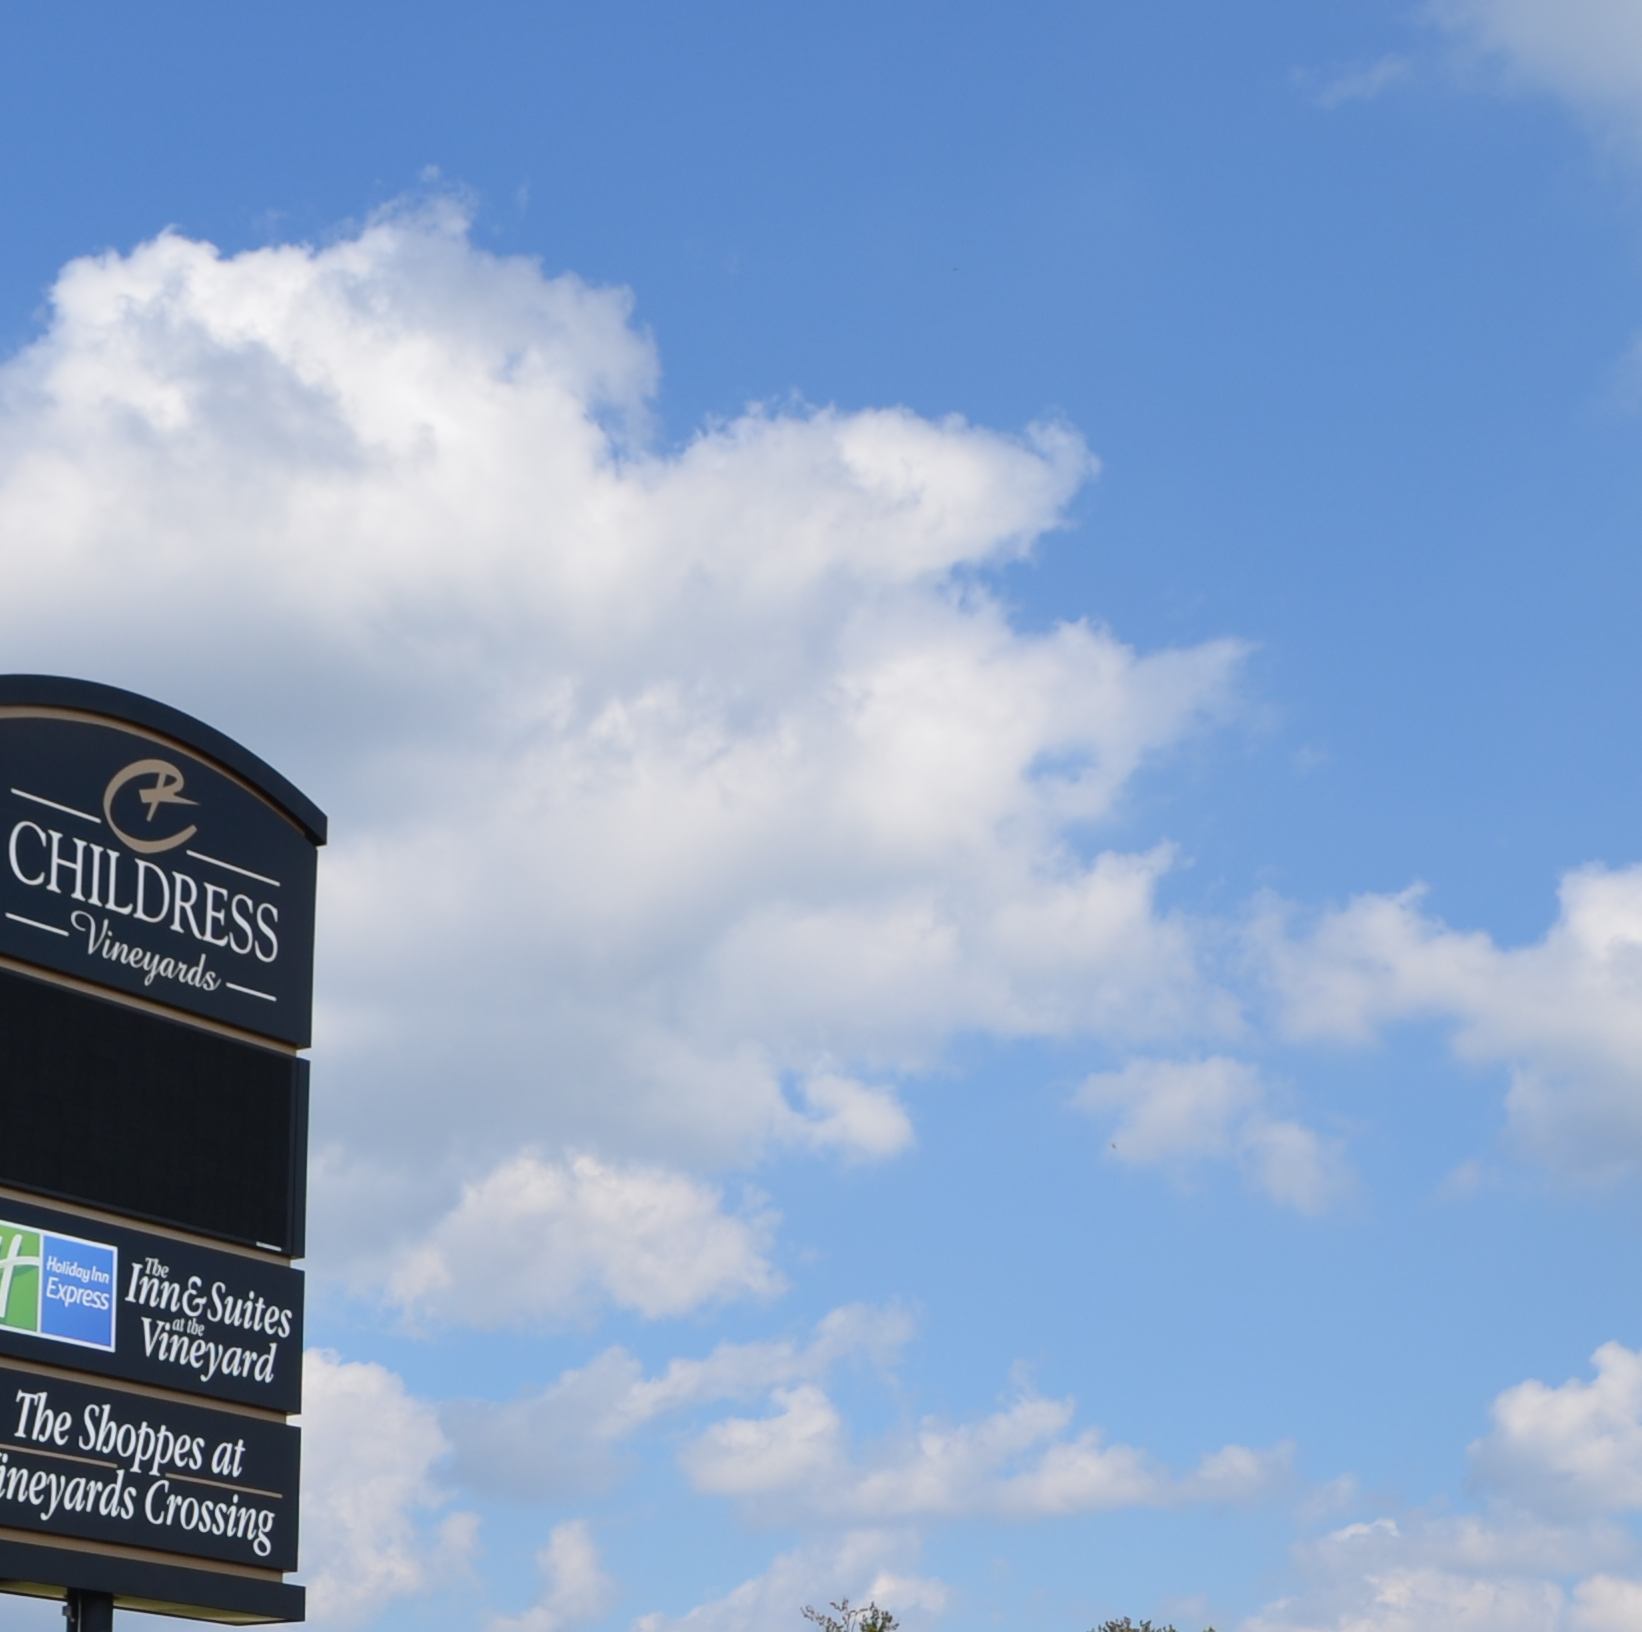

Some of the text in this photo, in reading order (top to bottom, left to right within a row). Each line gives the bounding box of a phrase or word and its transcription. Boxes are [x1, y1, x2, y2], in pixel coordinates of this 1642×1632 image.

[9, 821, 279, 963] CHILDRESS
[70, 910, 221, 991] Vineyards
[46, 1255, 109, 1283] Holiday Inn
[46, 1277, 110, 1310] Express
[145, 1257, 169, 1278] The
[141, 1317, 276, 1383] Vineyard
[172, 1318, 205, 1336] at the
[14, 1389, 246, 1478] The Shoppes at
[145, 1480, 275, 1557] Crossing
